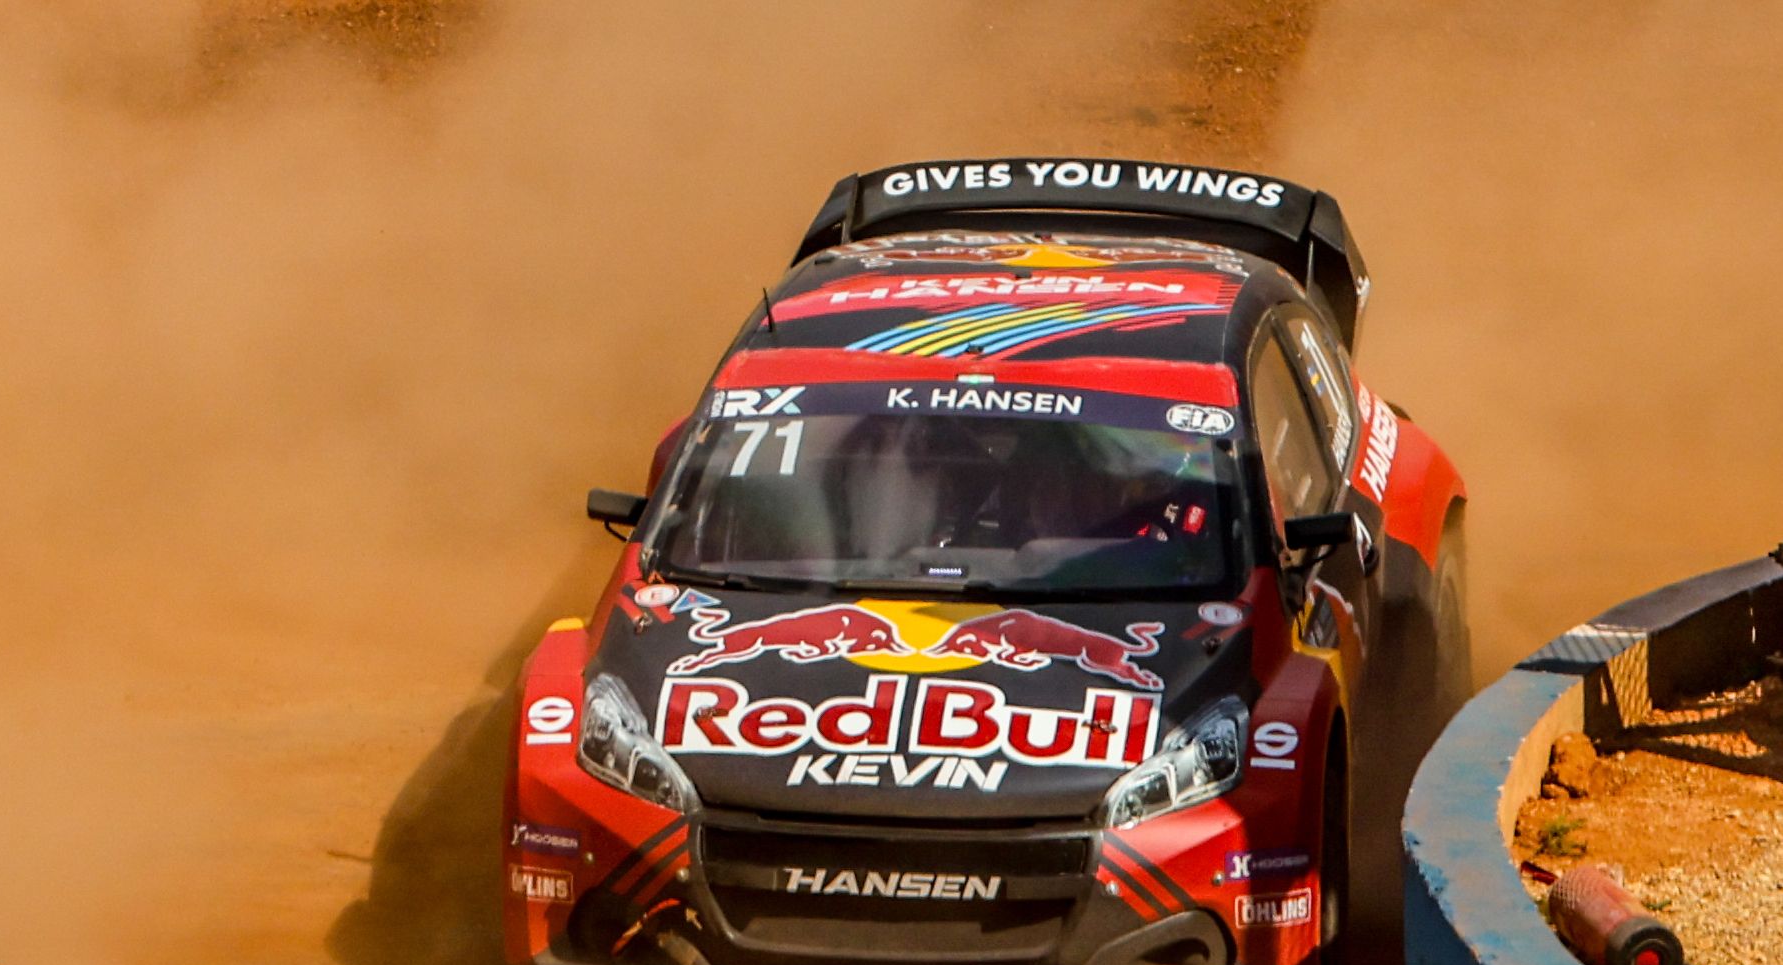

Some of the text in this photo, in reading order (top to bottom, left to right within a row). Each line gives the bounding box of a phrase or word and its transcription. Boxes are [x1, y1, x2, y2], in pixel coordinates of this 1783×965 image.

[881, 161, 1286, 208] GIVES YOU WINGS
[886, 387, 1083, 416] K. HANSEN
[1169, 405, 1230, 433] FIA
[729, 420, 805, 477] 71
[658, 674, 1162, 768] Red Bull
[786, 753, 1011, 792] KEVIN
[783, 866, 1002, 900] HANSEN
